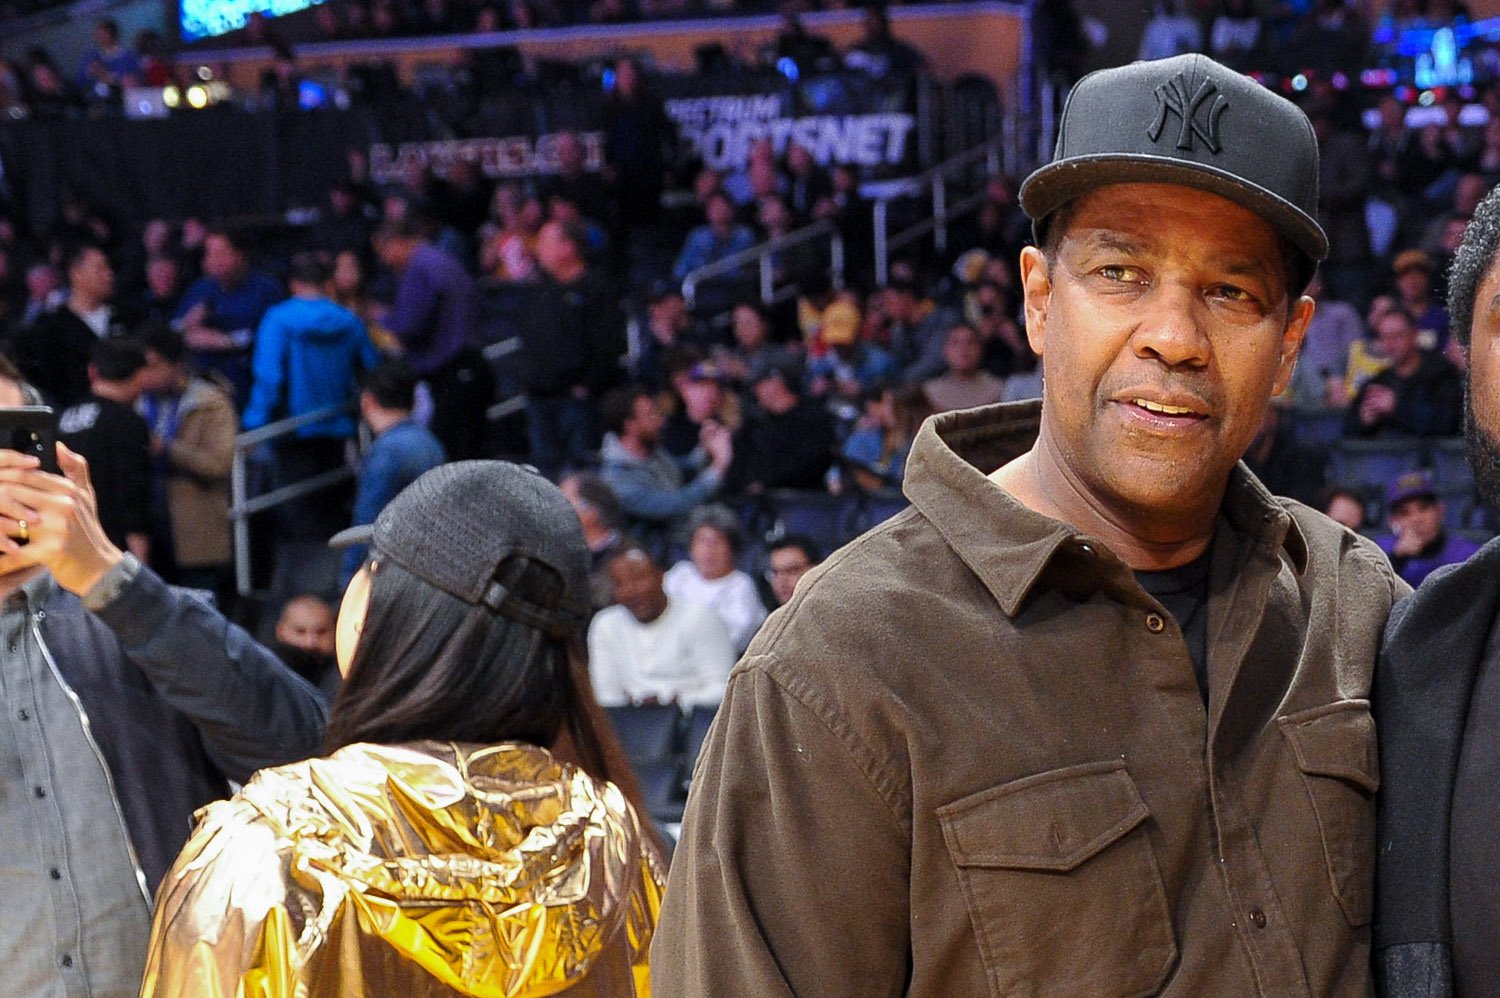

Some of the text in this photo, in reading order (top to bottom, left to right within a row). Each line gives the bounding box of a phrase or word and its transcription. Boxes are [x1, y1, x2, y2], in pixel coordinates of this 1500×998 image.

[664, 94, 781, 122] PECTRUM
[1147, 72, 1229, 155] NY
[680, 113, 914, 169] ORTSNET
